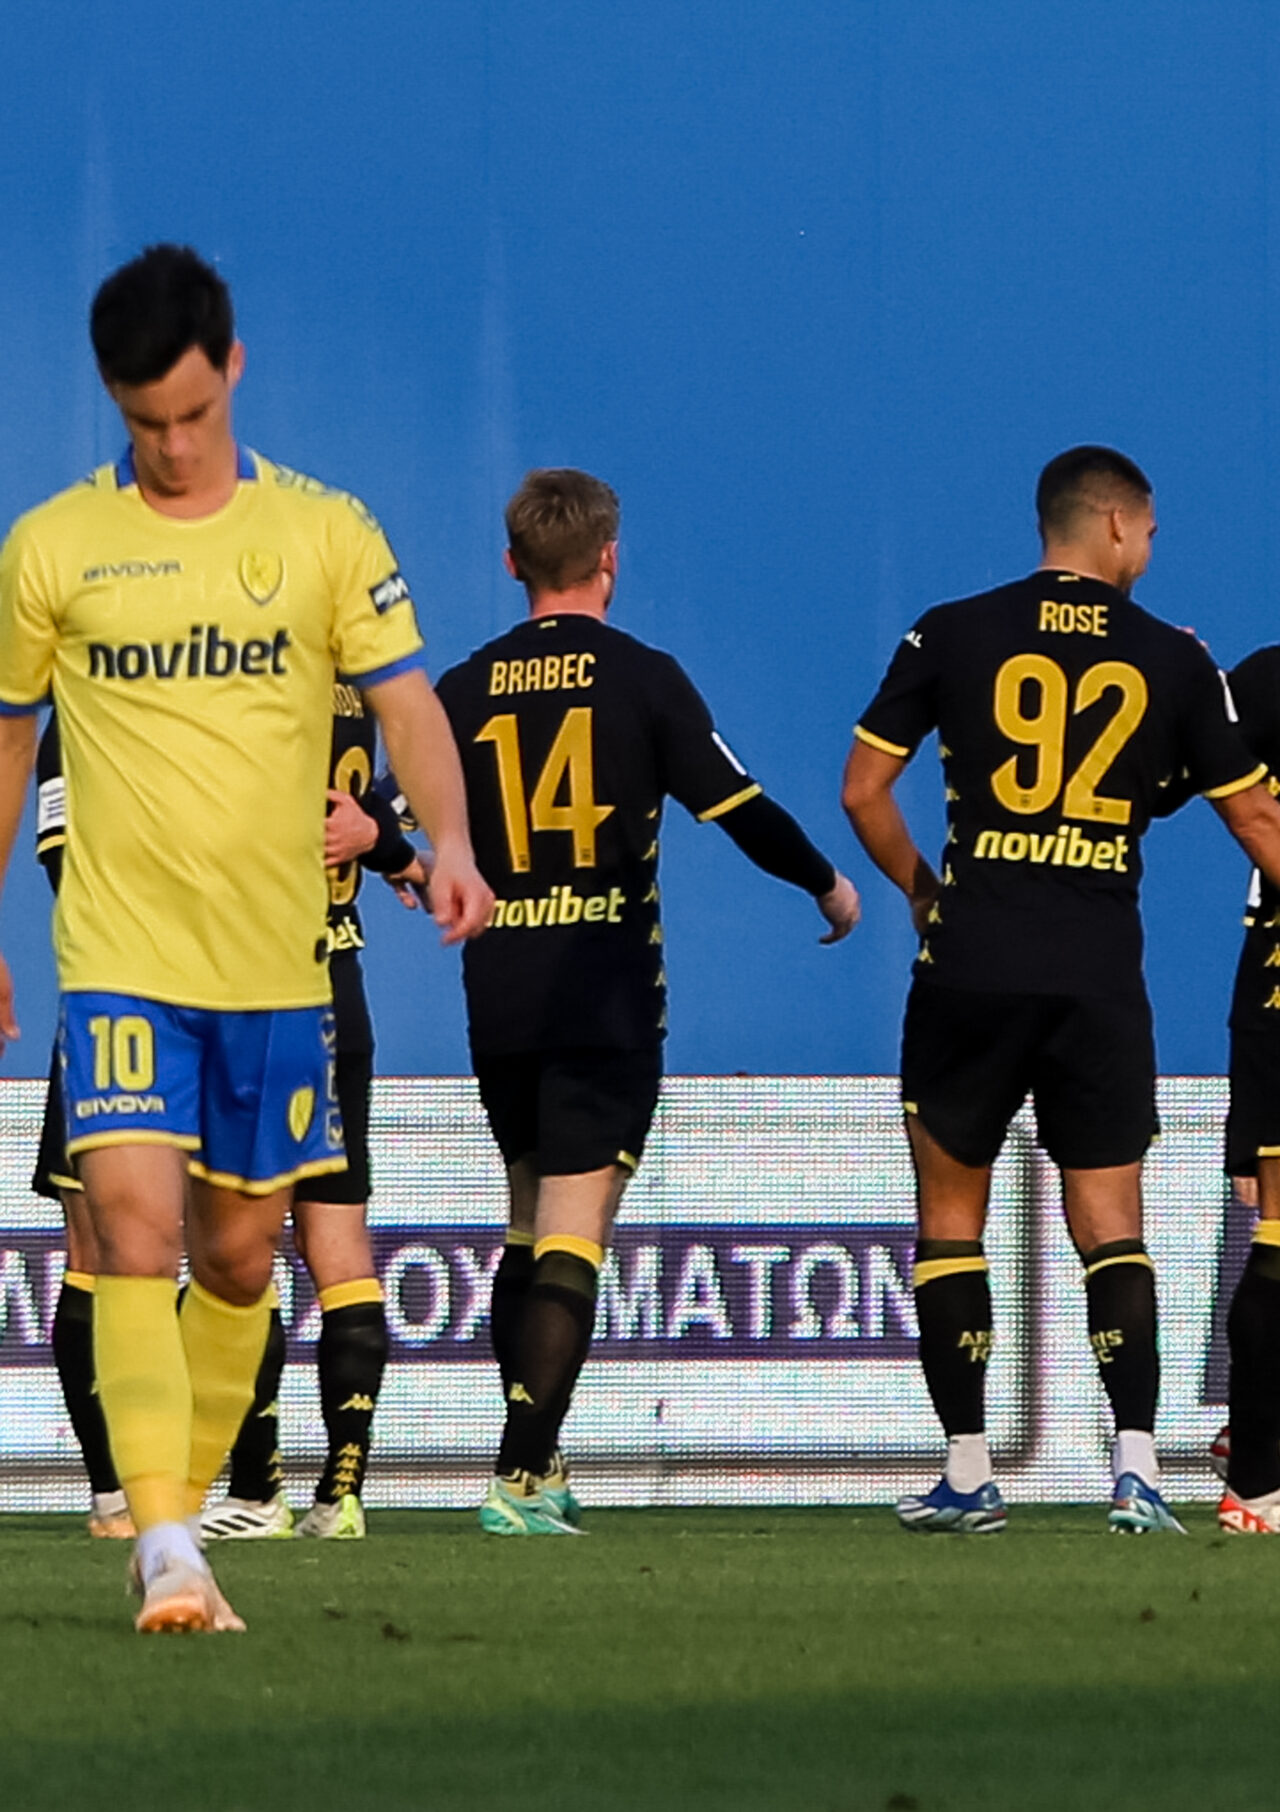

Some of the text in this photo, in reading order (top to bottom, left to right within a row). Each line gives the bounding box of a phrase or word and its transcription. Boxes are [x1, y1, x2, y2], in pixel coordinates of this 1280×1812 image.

[1039, 600, 1109, 637] ROSE
[88, 624, 291, 680] novibet
[489, 653, 596, 696] BRABEC
[990, 653, 1149, 825] 92
[473, 706, 616, 873] 14
[973, 825, 1129, 873] novibet
[486, 885, 627, 928] novibet
[89, 1015, 154, 1092] 10
